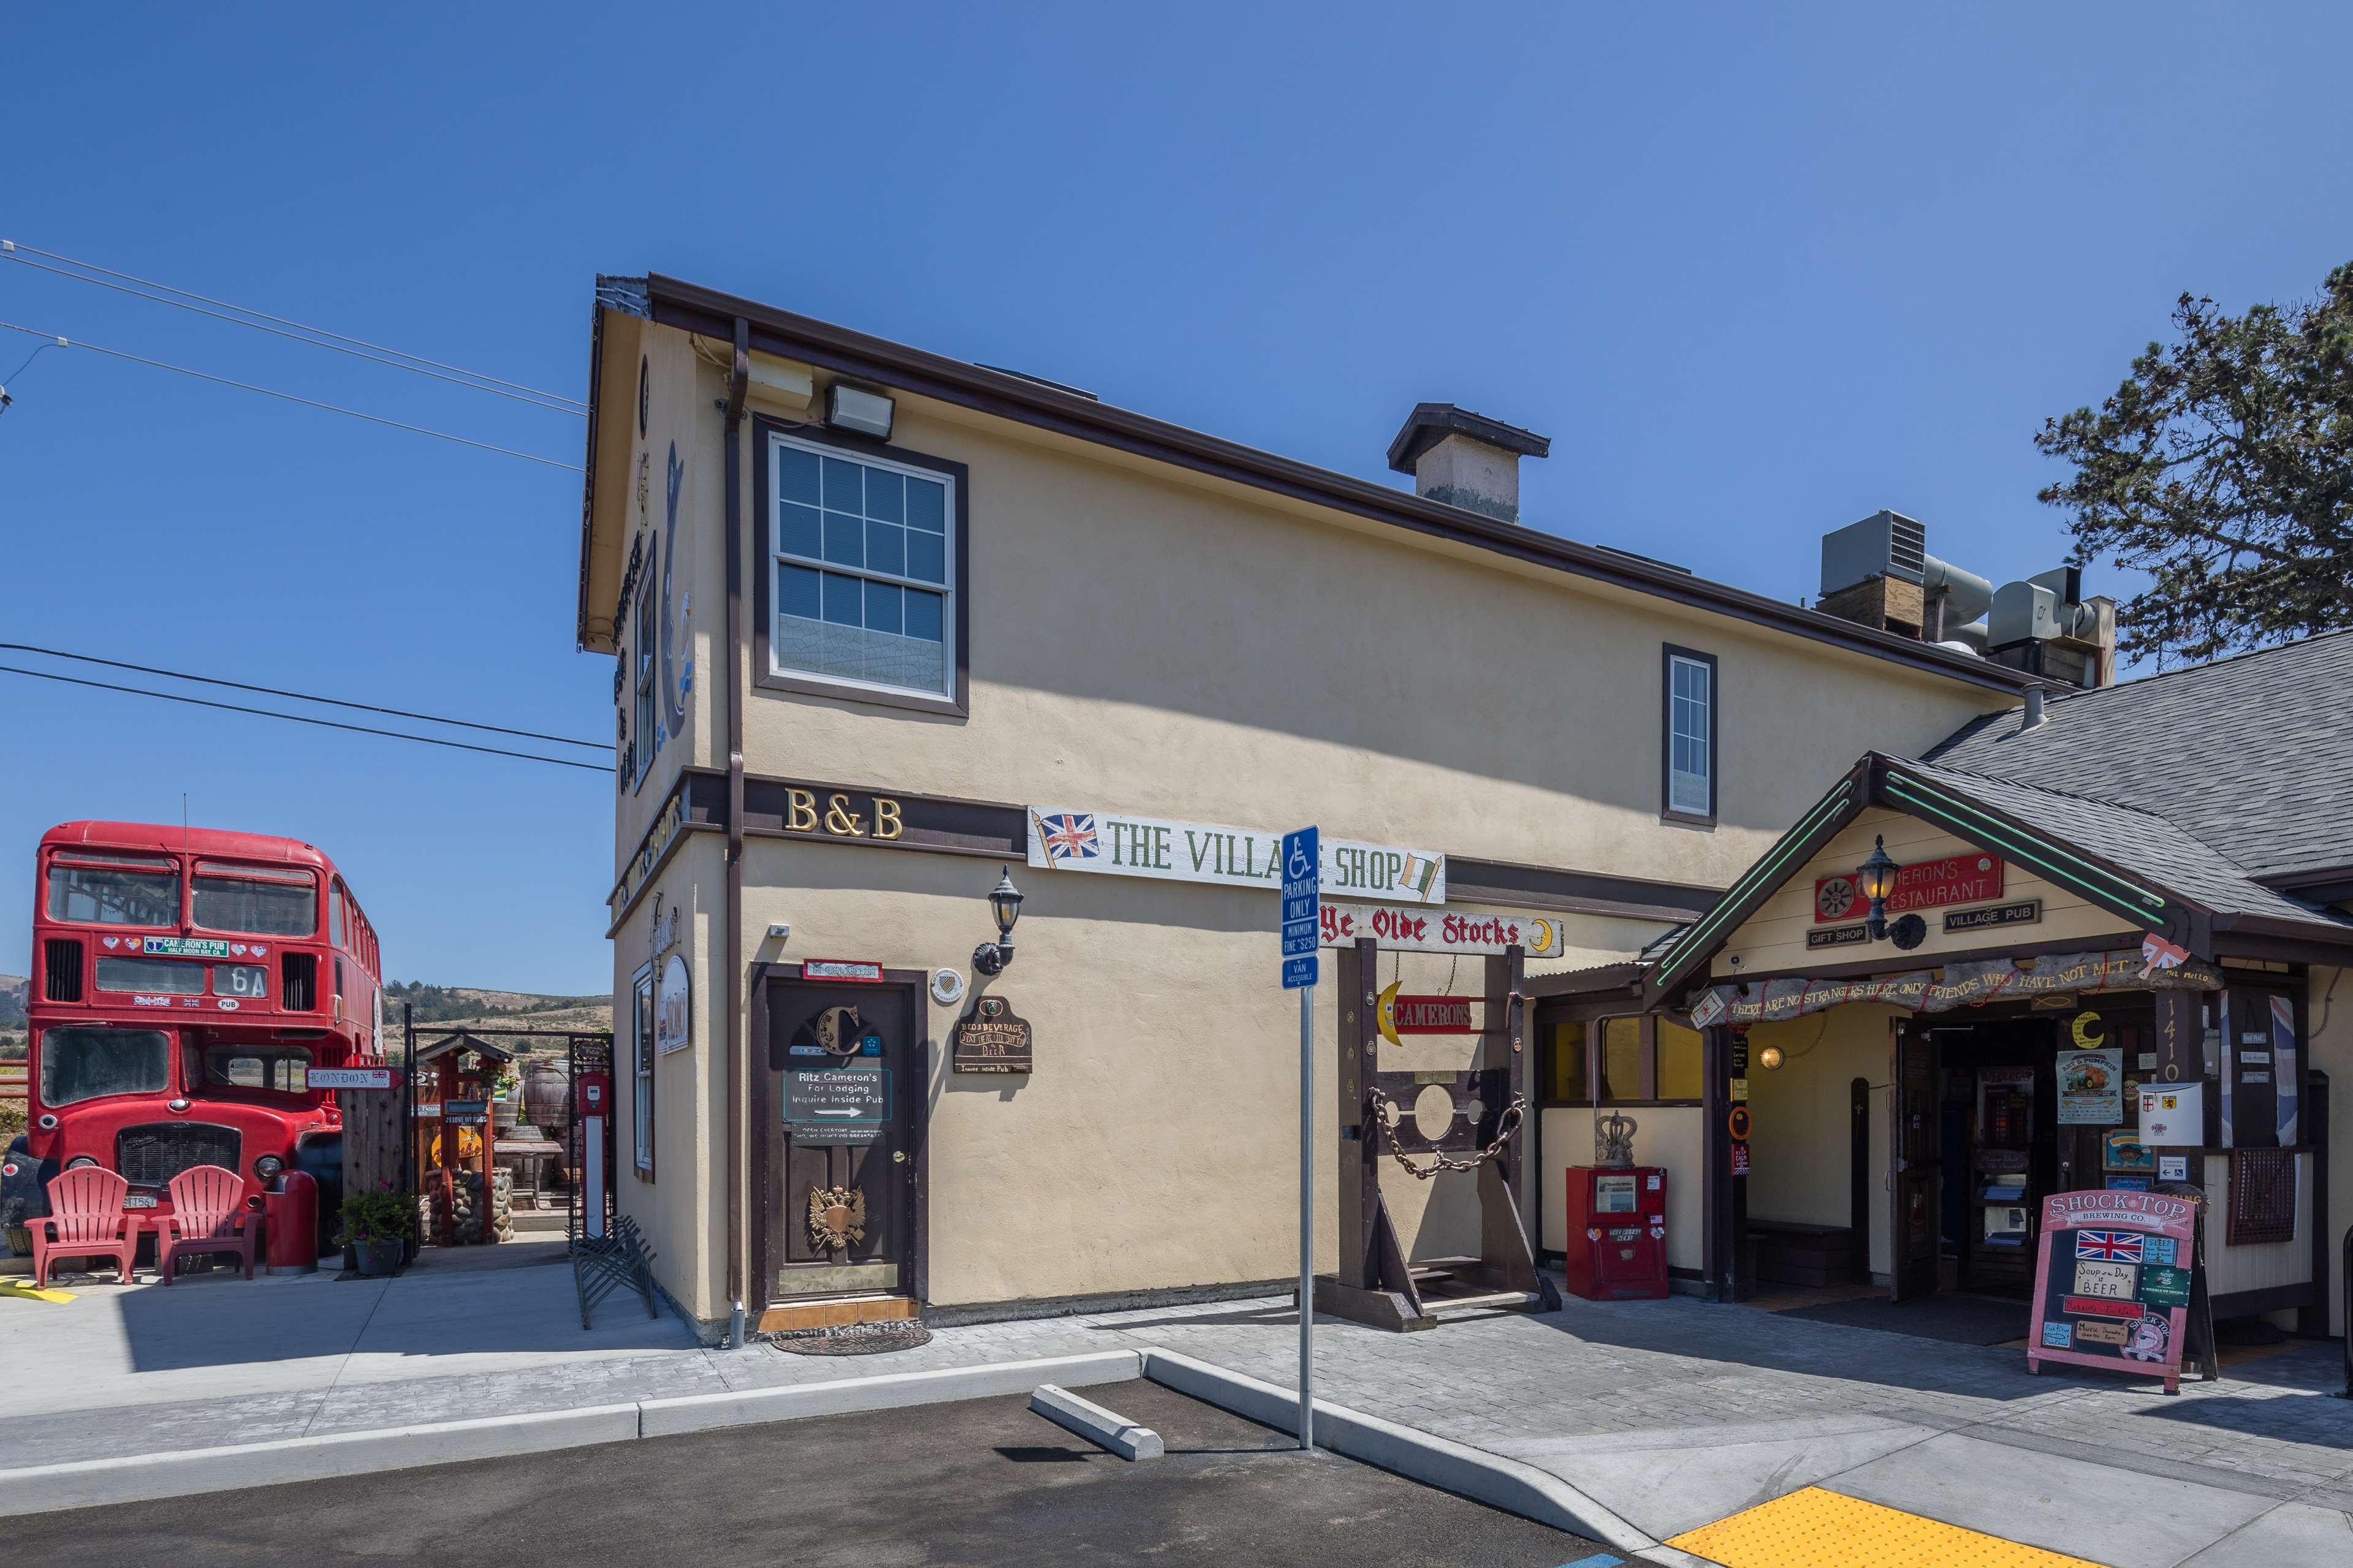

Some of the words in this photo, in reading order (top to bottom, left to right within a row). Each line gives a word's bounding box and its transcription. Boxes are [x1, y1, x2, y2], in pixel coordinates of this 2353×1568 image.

[1106, 821, 1172, 870] THE
[1336, 847, 1401, 891] SHOP
[1283, 876, 1317, 901] PARKING
[1882, 879, 1987, 910] ESTAURANT
[1290, 898, 1310, 918] ONLY
[1319, 905, 1355, 942] Ye
[1372, 908, 1427, 942] Olde
[1442, 913, 1519, 945] Stocks
[1949, 912, 1998, 927] VILLAGE
[2005, 907, 2031, 919] PUB
[1288, 924, 1312, 941] MINIMUM
[1811, 932, 1831, 944] GIFT
[1836, 928, 1863, 941] SHOP
[164, 939, 208, 949] CAMERON'S
[1284, 941, 1296, 953] FINE
[1299, 936, 1317, 951] $250
[1293, 963, 1307, 974] VAN
[1287, 973, 1312, 983] ACCESSIBLE
[1731, 1003, 1762, 1015] THERE
[1765, 996, 1785, 1012] ARE
[1787, 994, 1801, 1006] NO
[1803, 984, 1865, 1004] STRANGERS
[1899, 982, 1926, 996] ONLY
[1928, 978, 1980, 1001] FRIENDS
[1982, 972, 2013, 987] WHO
[2018, 974, 2056, 989] HAVE
[2059, 965, 2088, 985] NOT
[2092, 960, 2129, 976] MET
[1394, 1002, 1472, 1026] CAMERONS
[983, 1023, 1024, 1033] BEVERAGE
[310, 1073, 368, 1084] LONDON
[799, 1073, 819, 1082] Ritz
[824, 1073, 878, 1082] Cameron's
[829, 1085, 869, 1094] Lodging
[793, 1096, 826, 1105] Inquire
[2050, 1194, 2129, 1214] SHOCK
[2137, 1195, 2187, 1218] TOP
[2083, 1282, 2117, 1296] BEER
